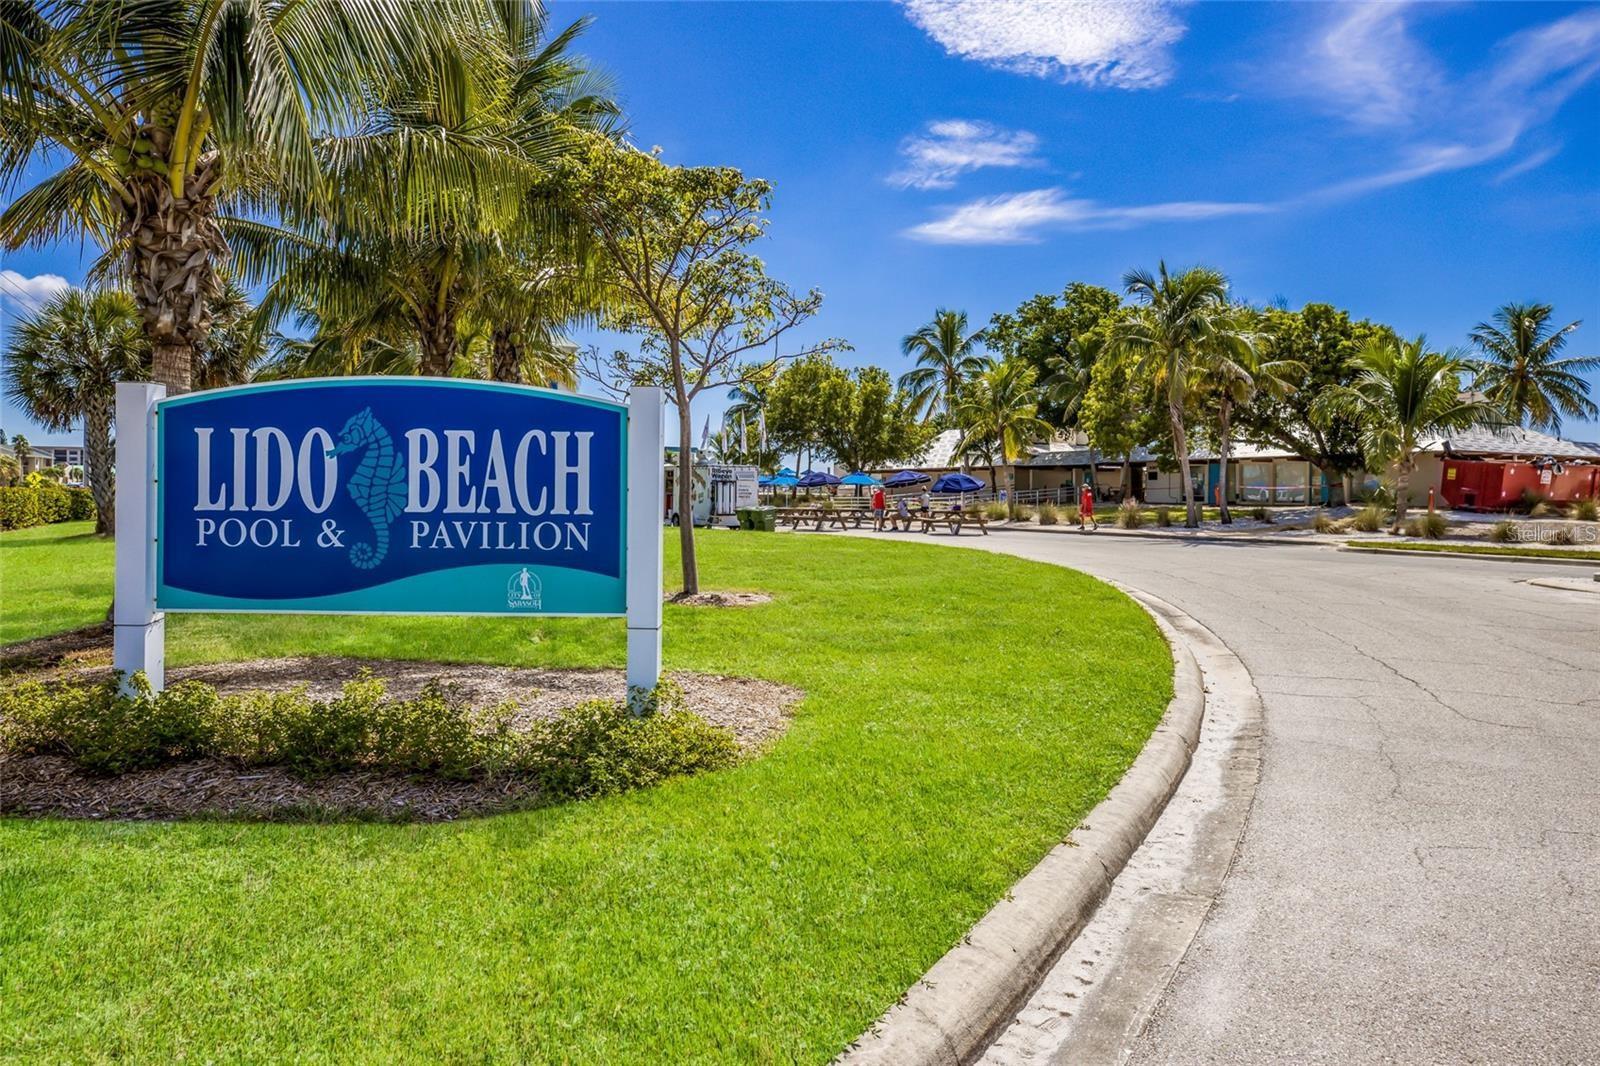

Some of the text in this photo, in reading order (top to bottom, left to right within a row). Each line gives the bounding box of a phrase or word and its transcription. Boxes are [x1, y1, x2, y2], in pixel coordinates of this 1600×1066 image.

[193, 426, 594, 516] LIDO BEACH
[196, 518, 591, 551] POOL & PAVILION
